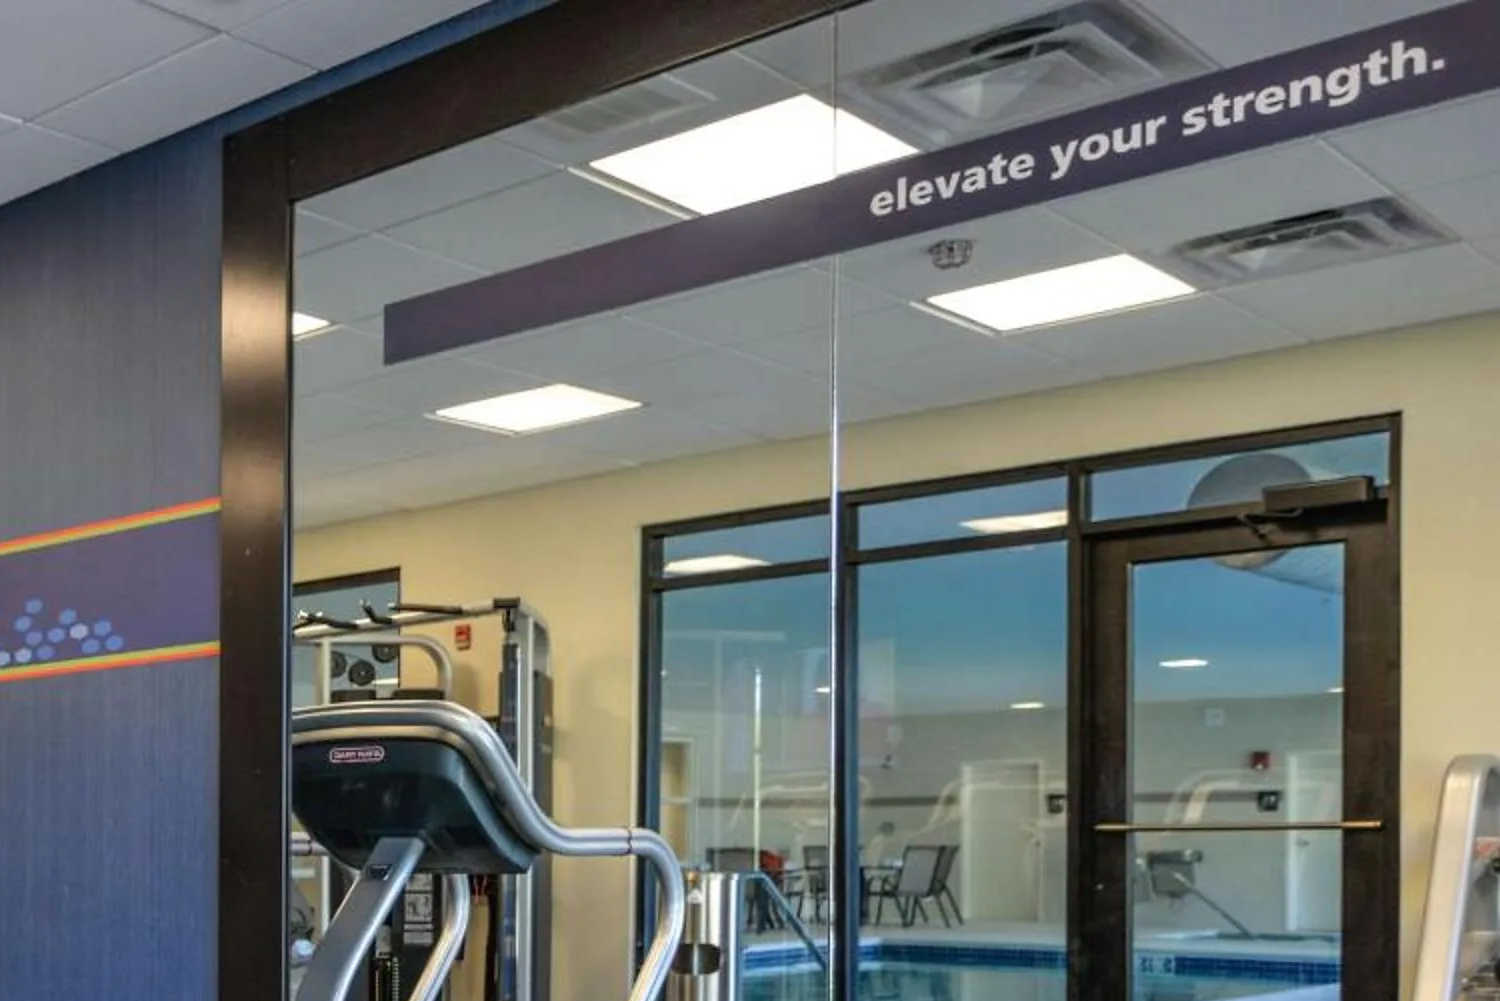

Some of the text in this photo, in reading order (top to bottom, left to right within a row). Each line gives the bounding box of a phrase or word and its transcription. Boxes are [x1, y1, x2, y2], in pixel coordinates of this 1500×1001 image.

[869, 41, 1446, 217] elevate your strength.
